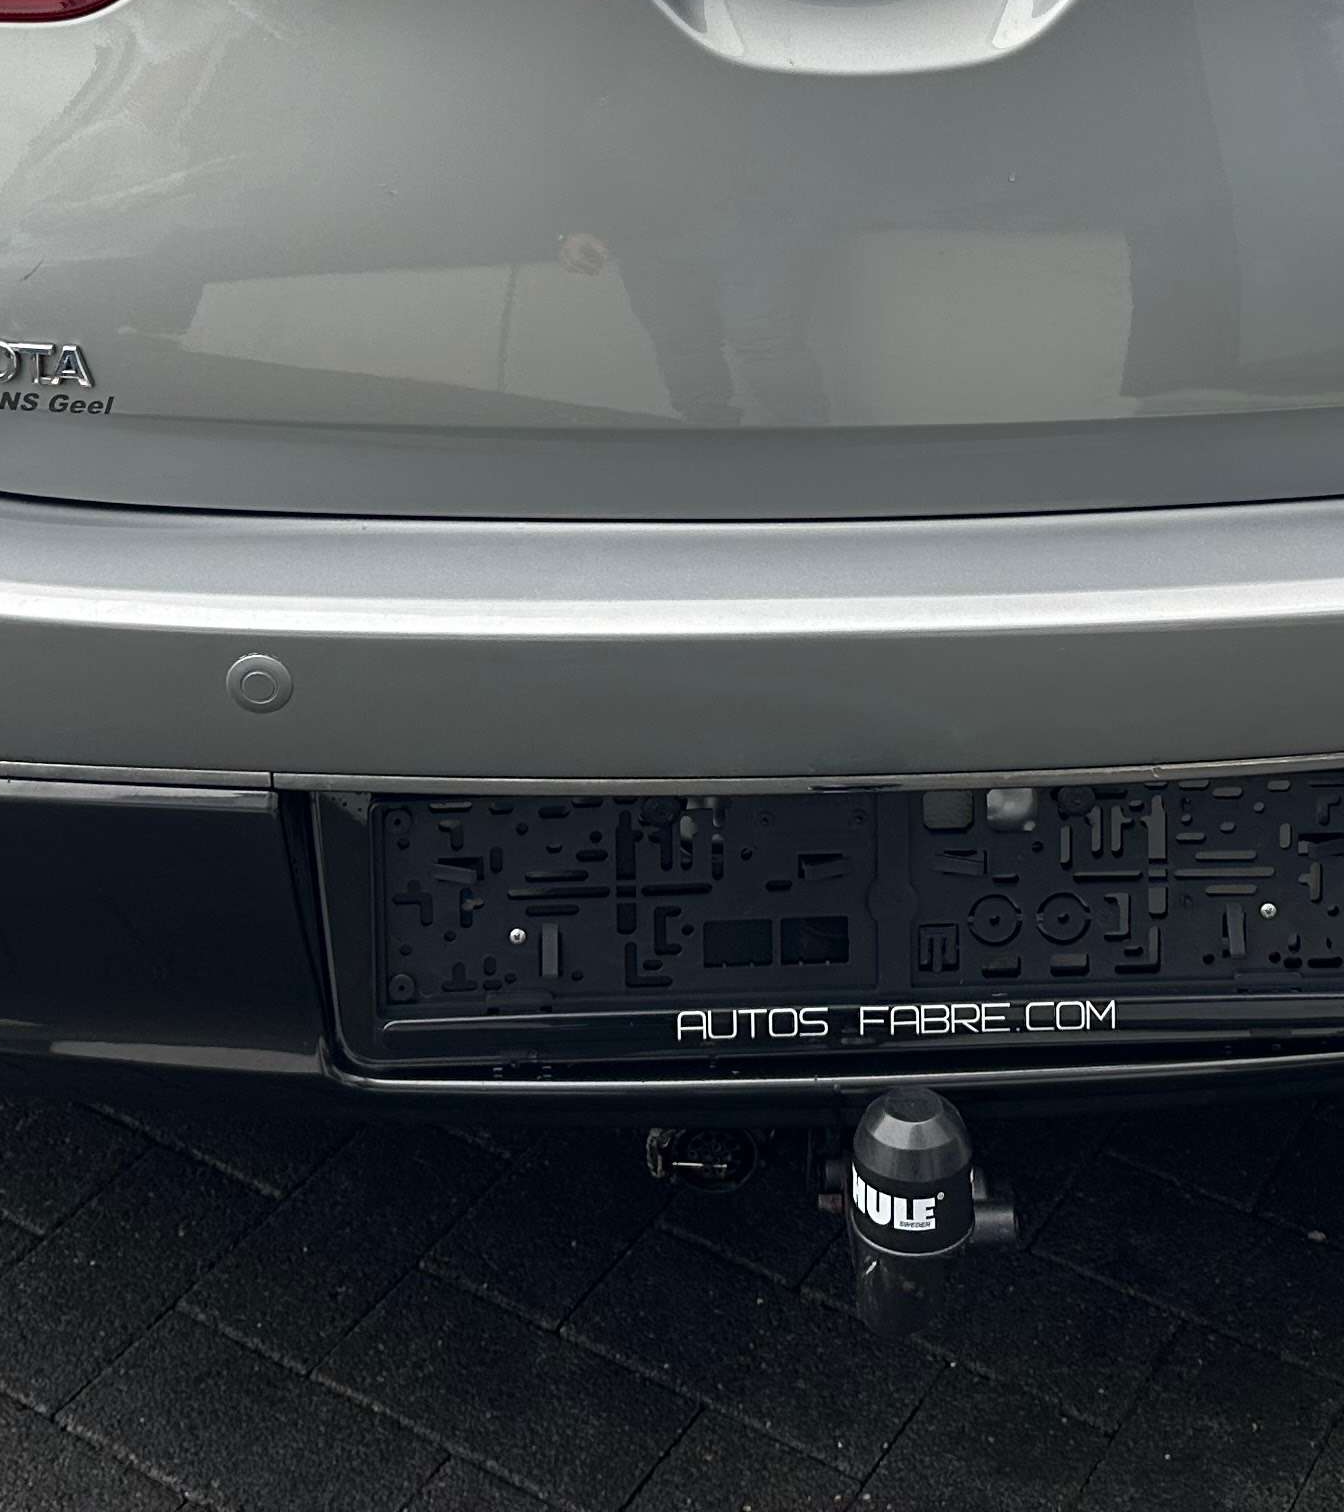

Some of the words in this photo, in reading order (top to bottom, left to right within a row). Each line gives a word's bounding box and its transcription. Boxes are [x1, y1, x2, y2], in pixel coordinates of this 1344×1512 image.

[48, 394, 115, 416] Geel
[676, 1006, 829, 1041] AUTOS
[859, 999, 1117, 1037] FABRE.COM
[851, 1162, 937, 1232] HULE
